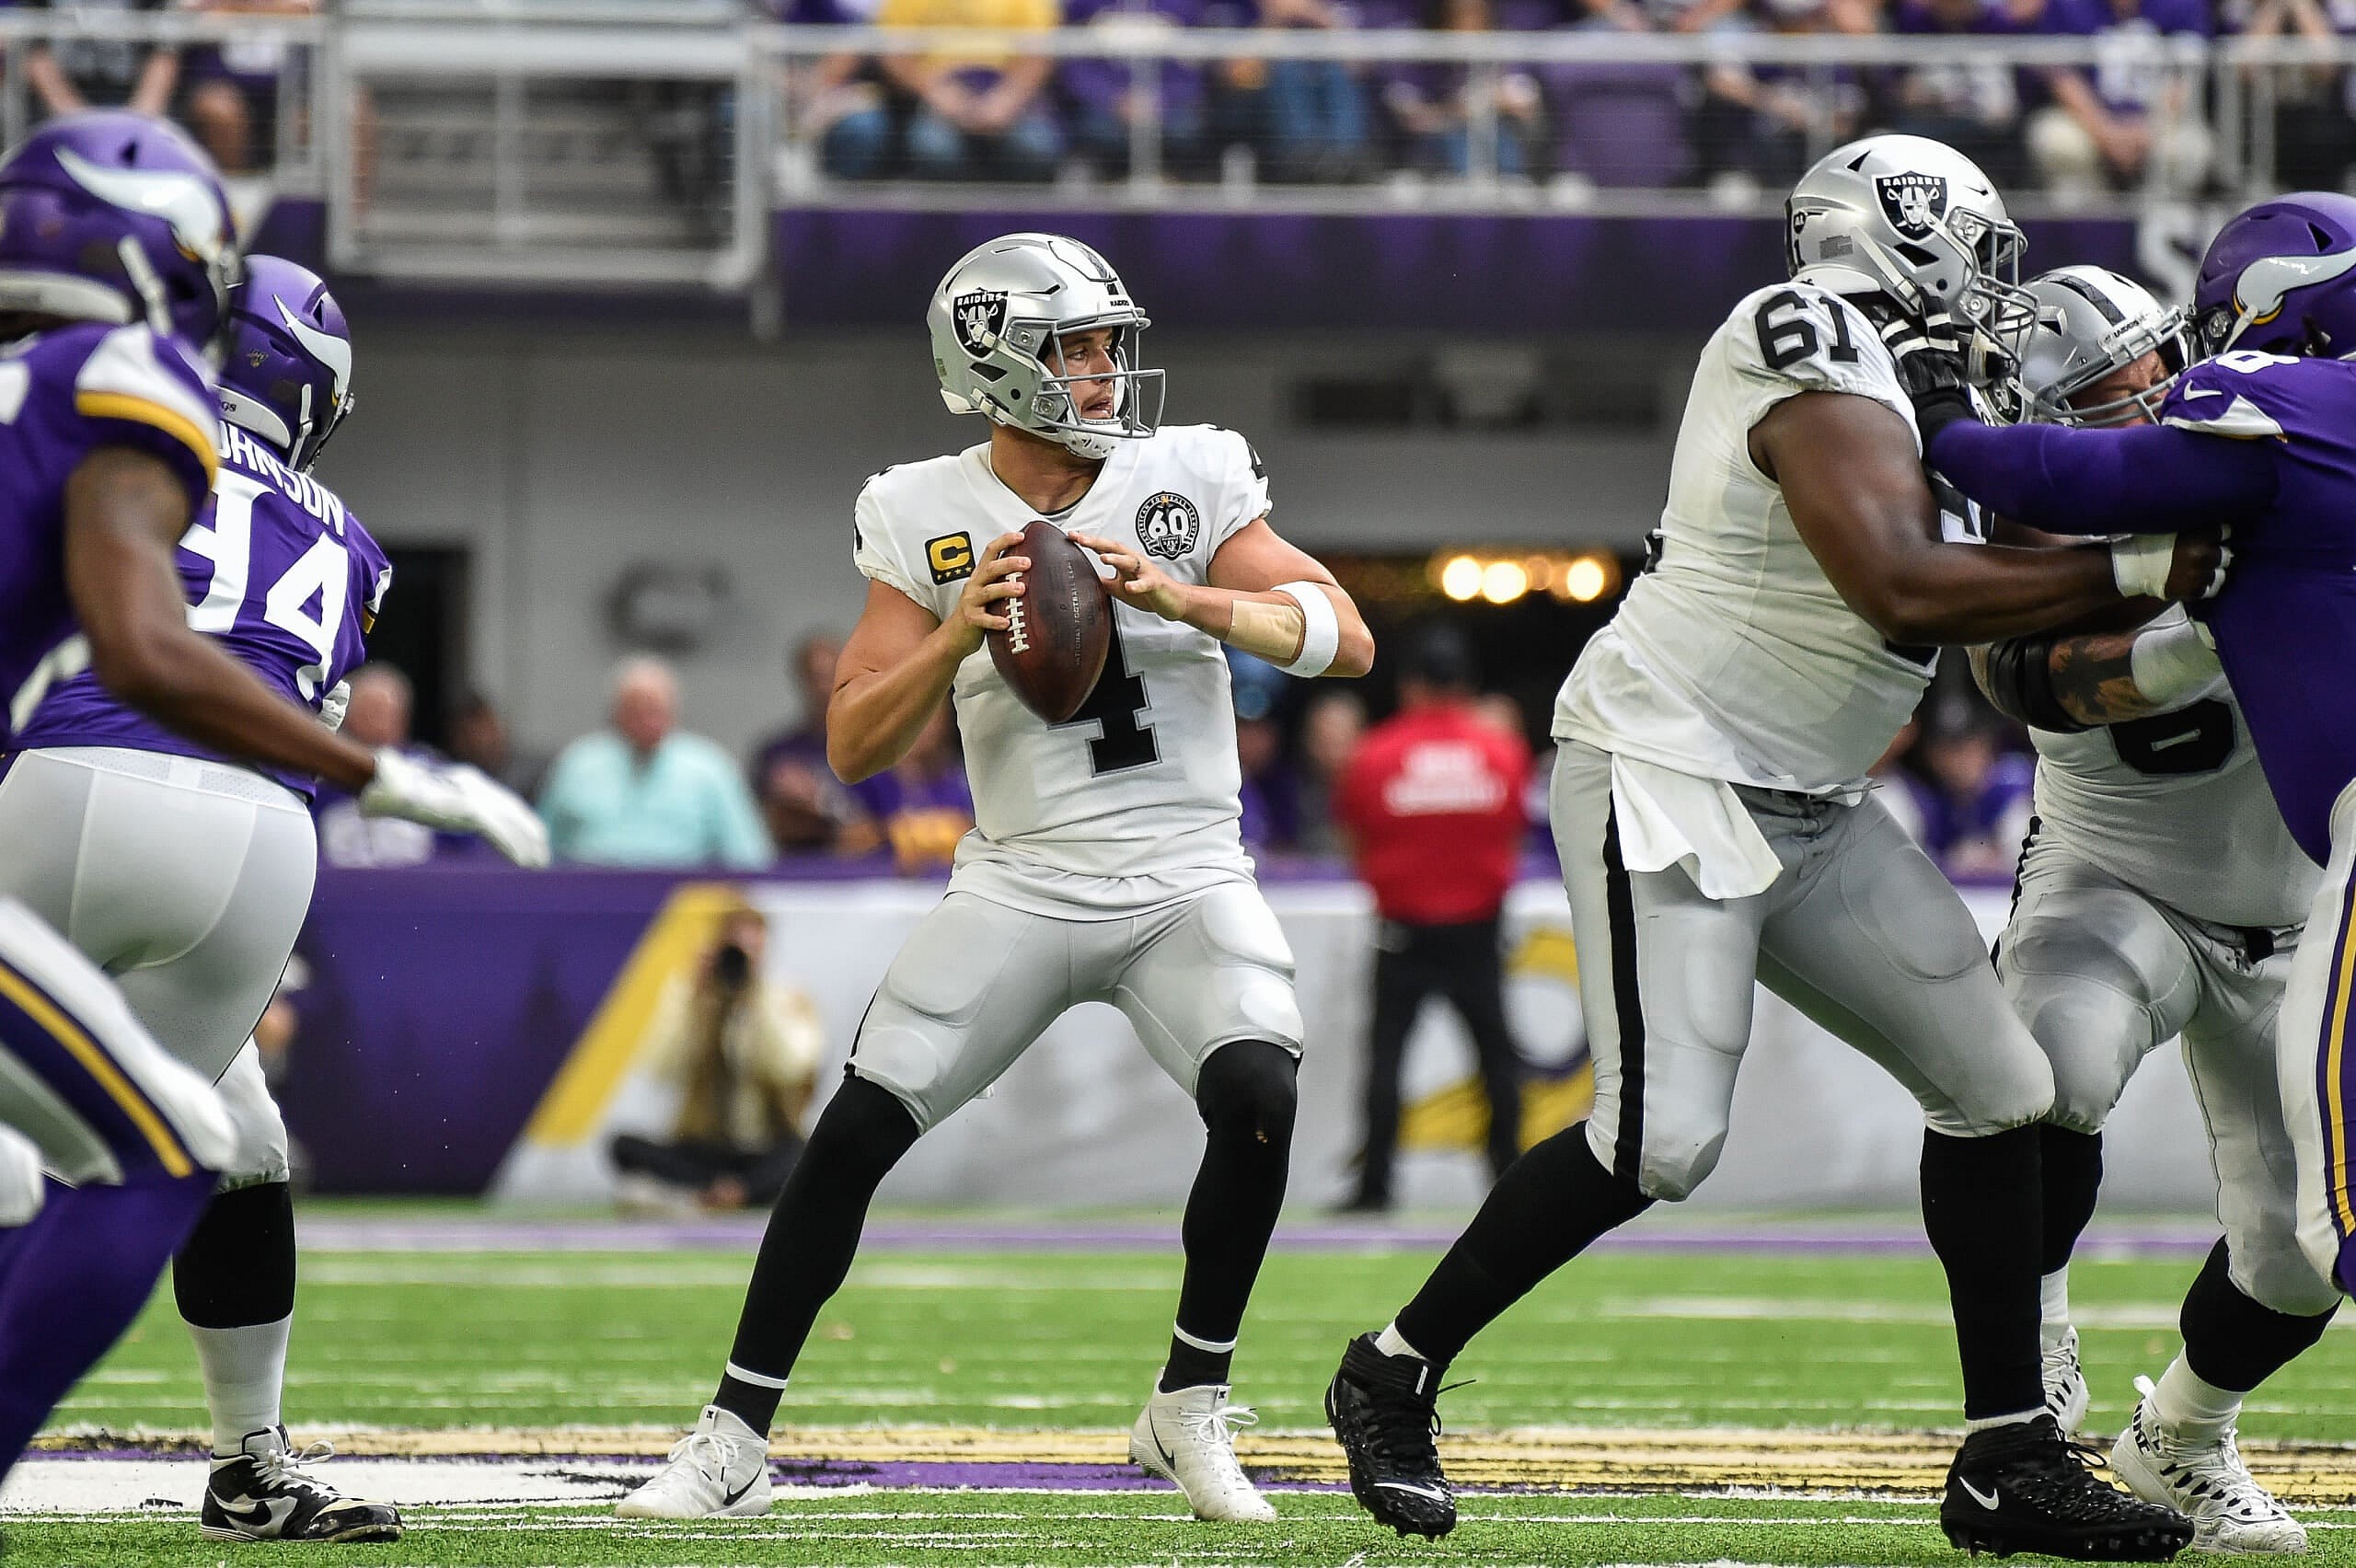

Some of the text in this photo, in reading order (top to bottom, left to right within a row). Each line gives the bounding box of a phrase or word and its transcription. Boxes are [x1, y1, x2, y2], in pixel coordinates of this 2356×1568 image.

[1883, 176, 1941, 187] RAIDERS
[957, 293, 1004, 306] RAIDERS
[1754, 290, 1859, 371] 61
[218, 420, 344, 537] OHNSON
[1149, 508, 1190, 539] 60
[930, 536, 970, 571] C
